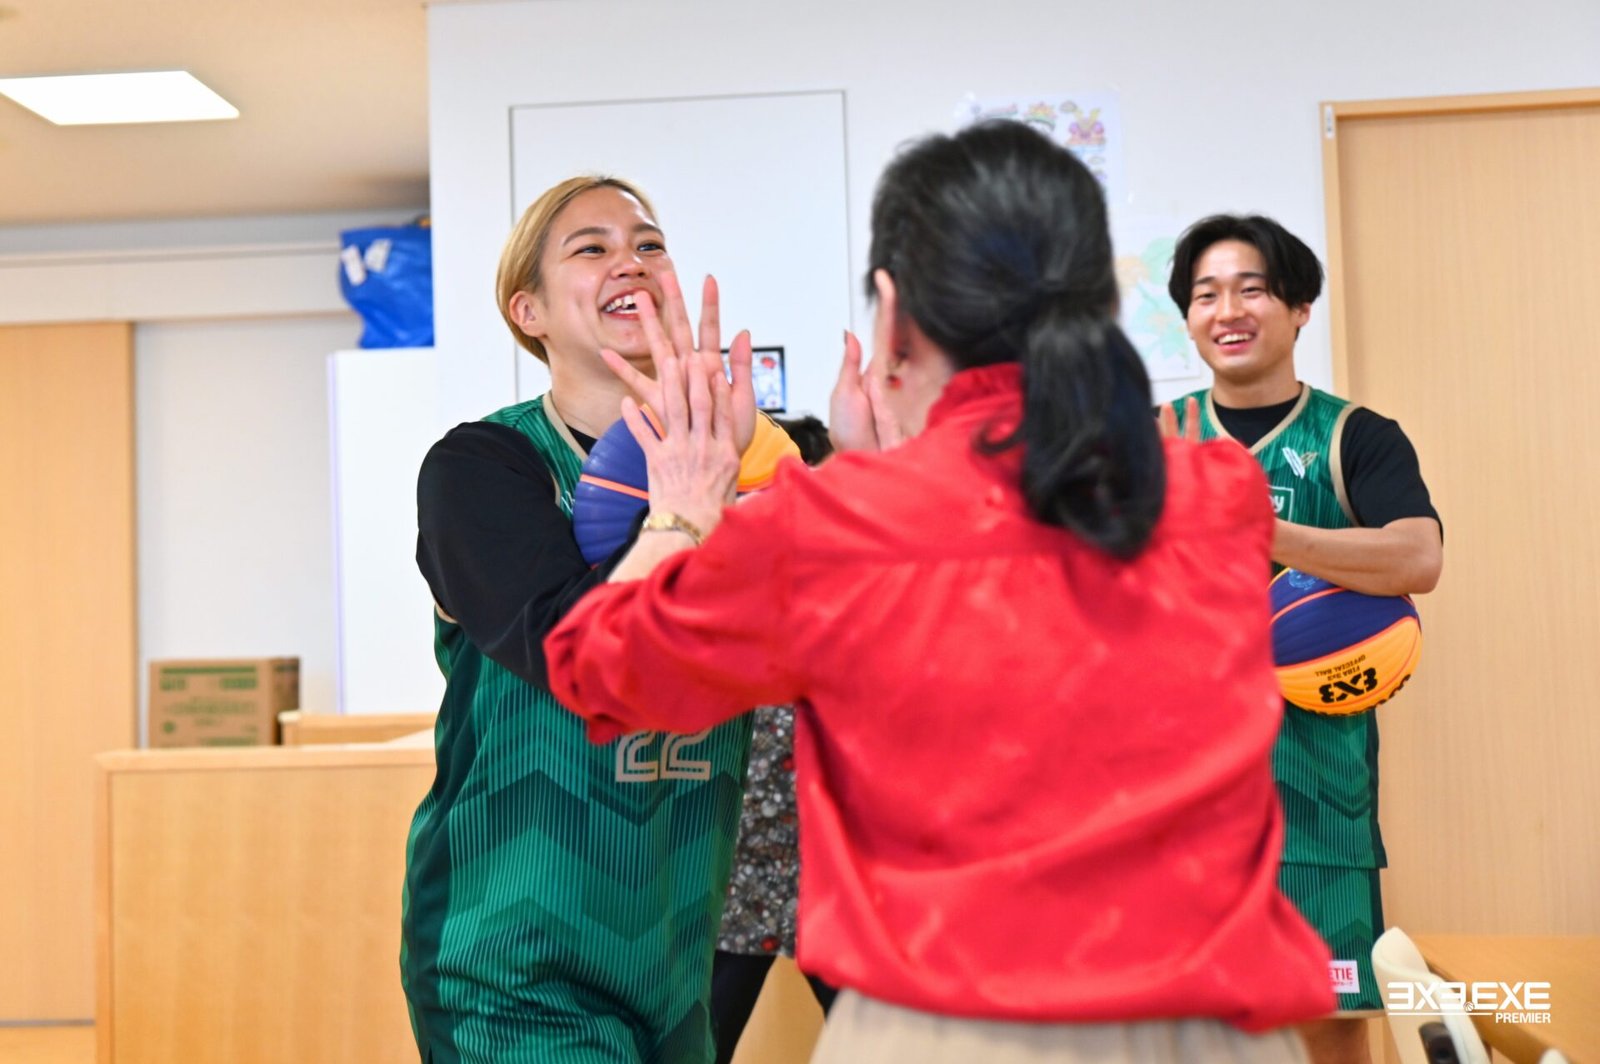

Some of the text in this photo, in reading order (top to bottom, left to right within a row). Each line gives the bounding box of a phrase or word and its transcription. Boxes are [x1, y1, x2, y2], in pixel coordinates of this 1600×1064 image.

[1315, 654, 1366, 677] OFFICIAL BALL
[1343, 665, 1360, 677] FIBA
[616, 727, 711, 782] 22
